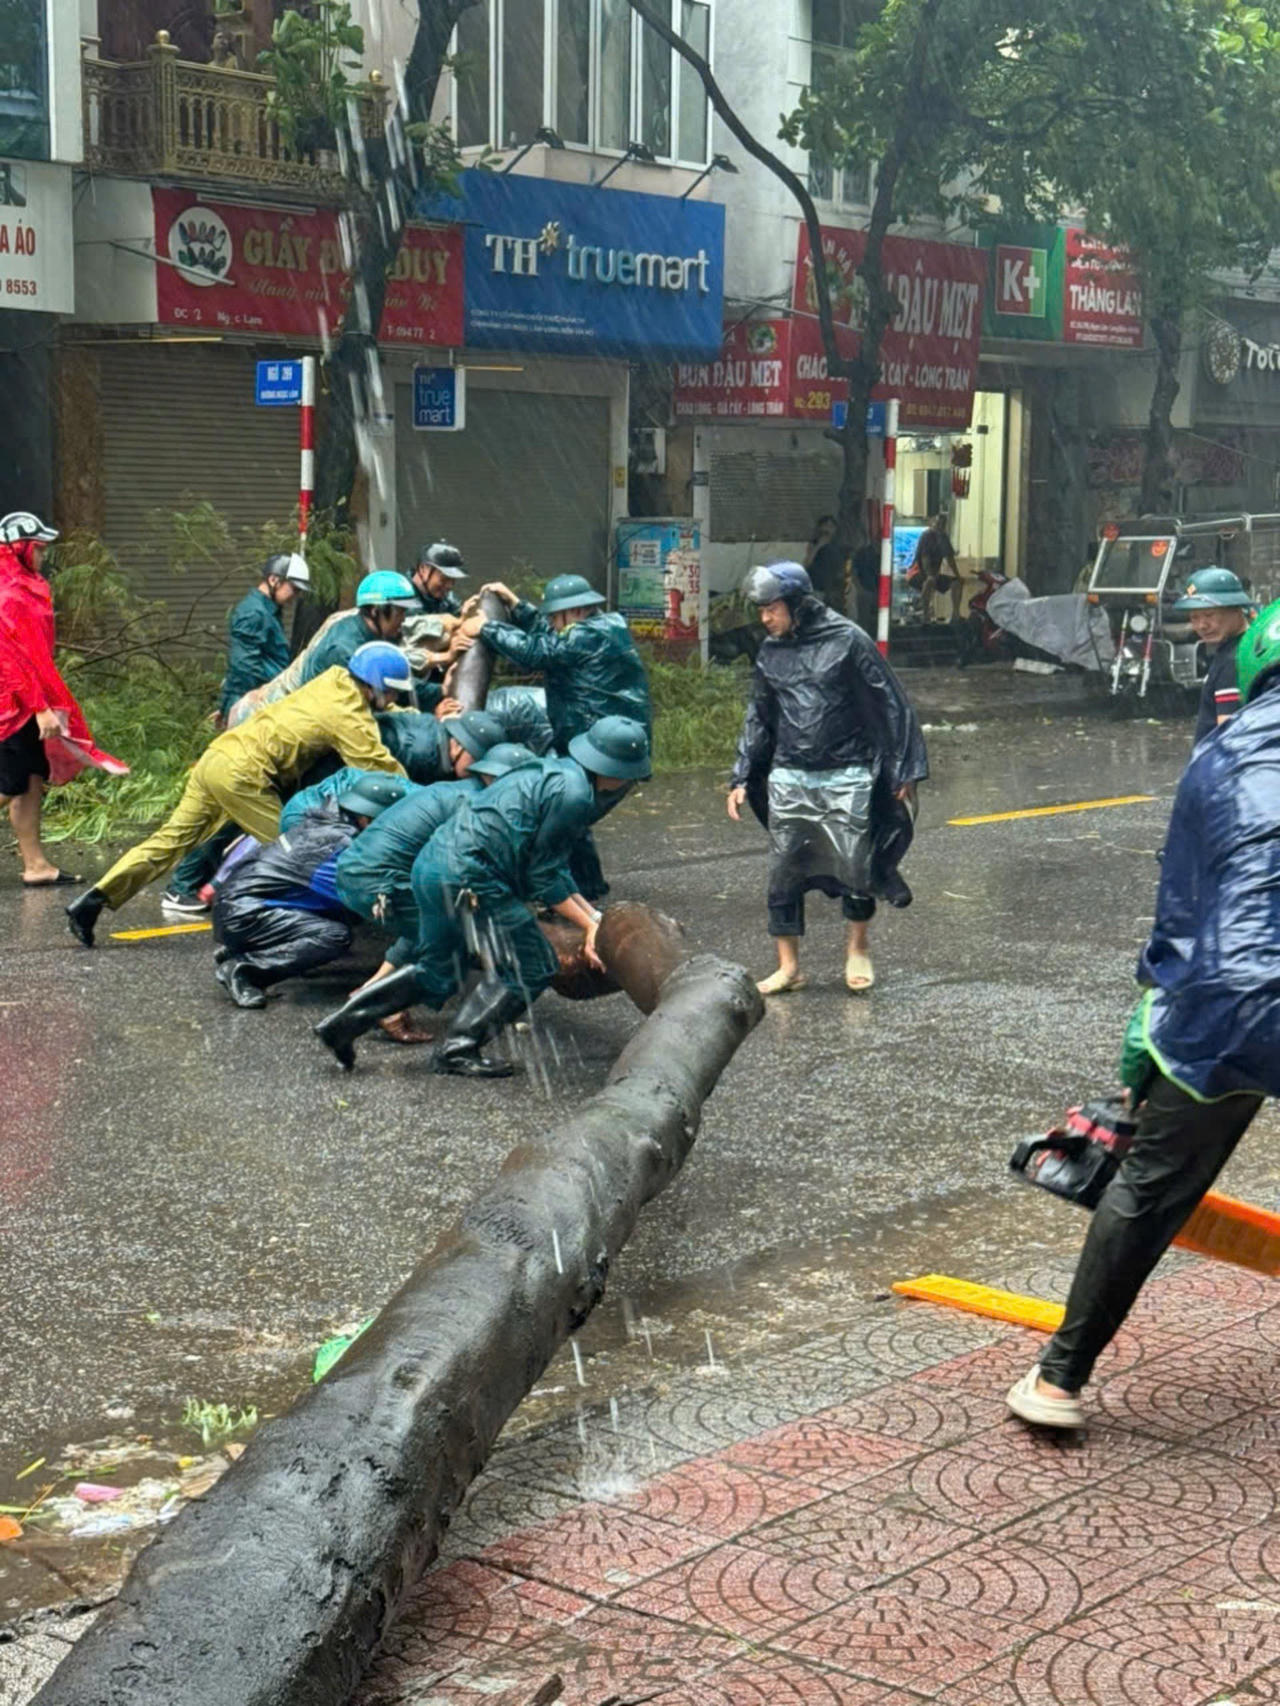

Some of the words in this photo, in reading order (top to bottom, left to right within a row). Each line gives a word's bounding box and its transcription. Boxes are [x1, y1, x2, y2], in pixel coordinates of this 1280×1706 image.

[14, 218, 36, 256] ÁO
[486, 233, 542, 277] TH
[6, 278, 37, 296] 8553
[1003, 259, 1041, 302] K+
[938, 278, 979, 355] MẸT
[750, 360, 783, 395] MẸT
[419, 385, 452, 407] true
[418, 406, 452, 424] mart
